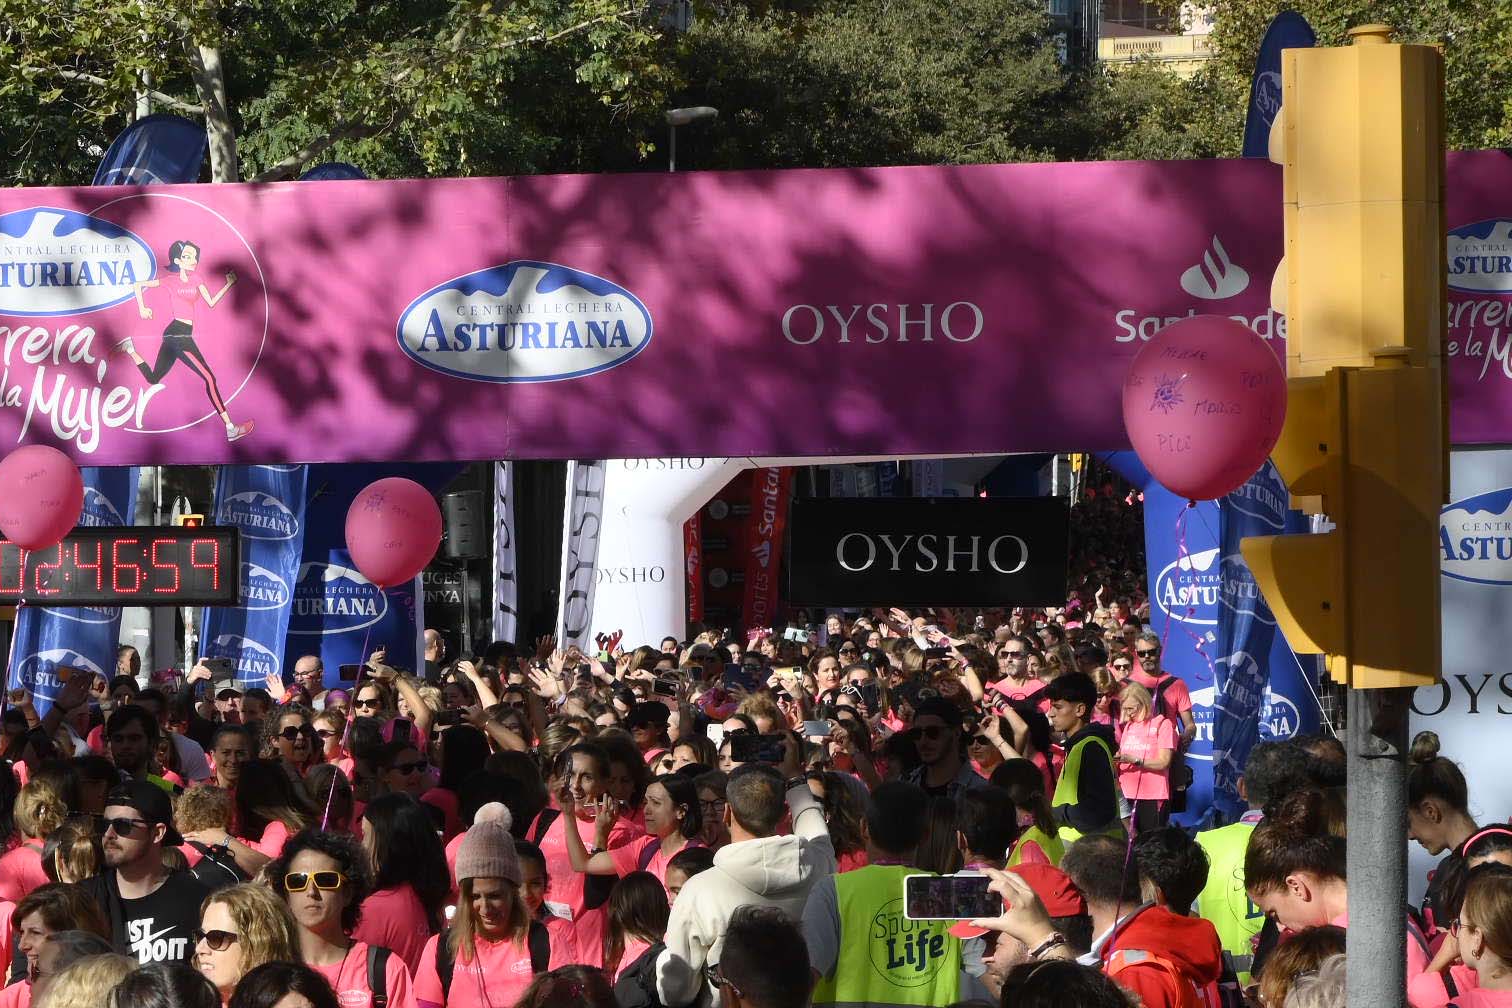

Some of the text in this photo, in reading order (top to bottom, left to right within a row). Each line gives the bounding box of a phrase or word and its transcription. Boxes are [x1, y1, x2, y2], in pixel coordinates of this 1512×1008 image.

[60, 243, 131, 255] LECHERA
[417, 308, 632, 352] ASTURIANA
[456, 302, 624, 316] CENTRAL LECHERA
[782, 302, 984, 345] OYSHO
[1465, 330, 1482, 357] la
[17, 360, 166, 454] Mujer
[836, 533, 1029, 574] OYSHO
[886, 928, 944, 971] Life
